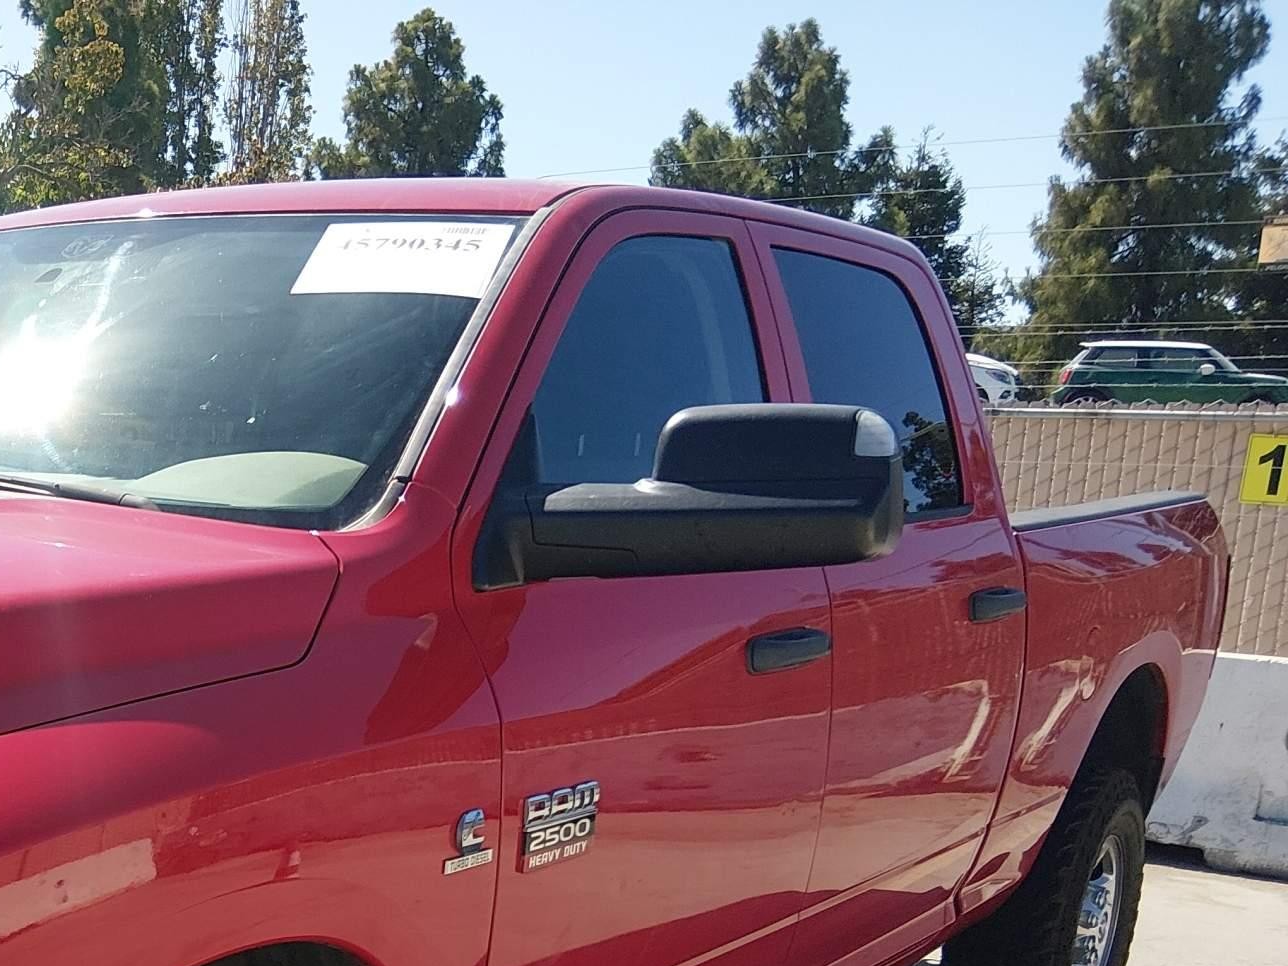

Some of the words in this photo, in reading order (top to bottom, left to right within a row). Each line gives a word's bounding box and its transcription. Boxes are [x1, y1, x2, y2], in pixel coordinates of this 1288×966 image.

[1259, 444, 1287, 495] 1
[530, 818, 590, 851] 2500
[528, 850, 561, 869] HEAVY
[563, 840, 588, 857] DUTY
